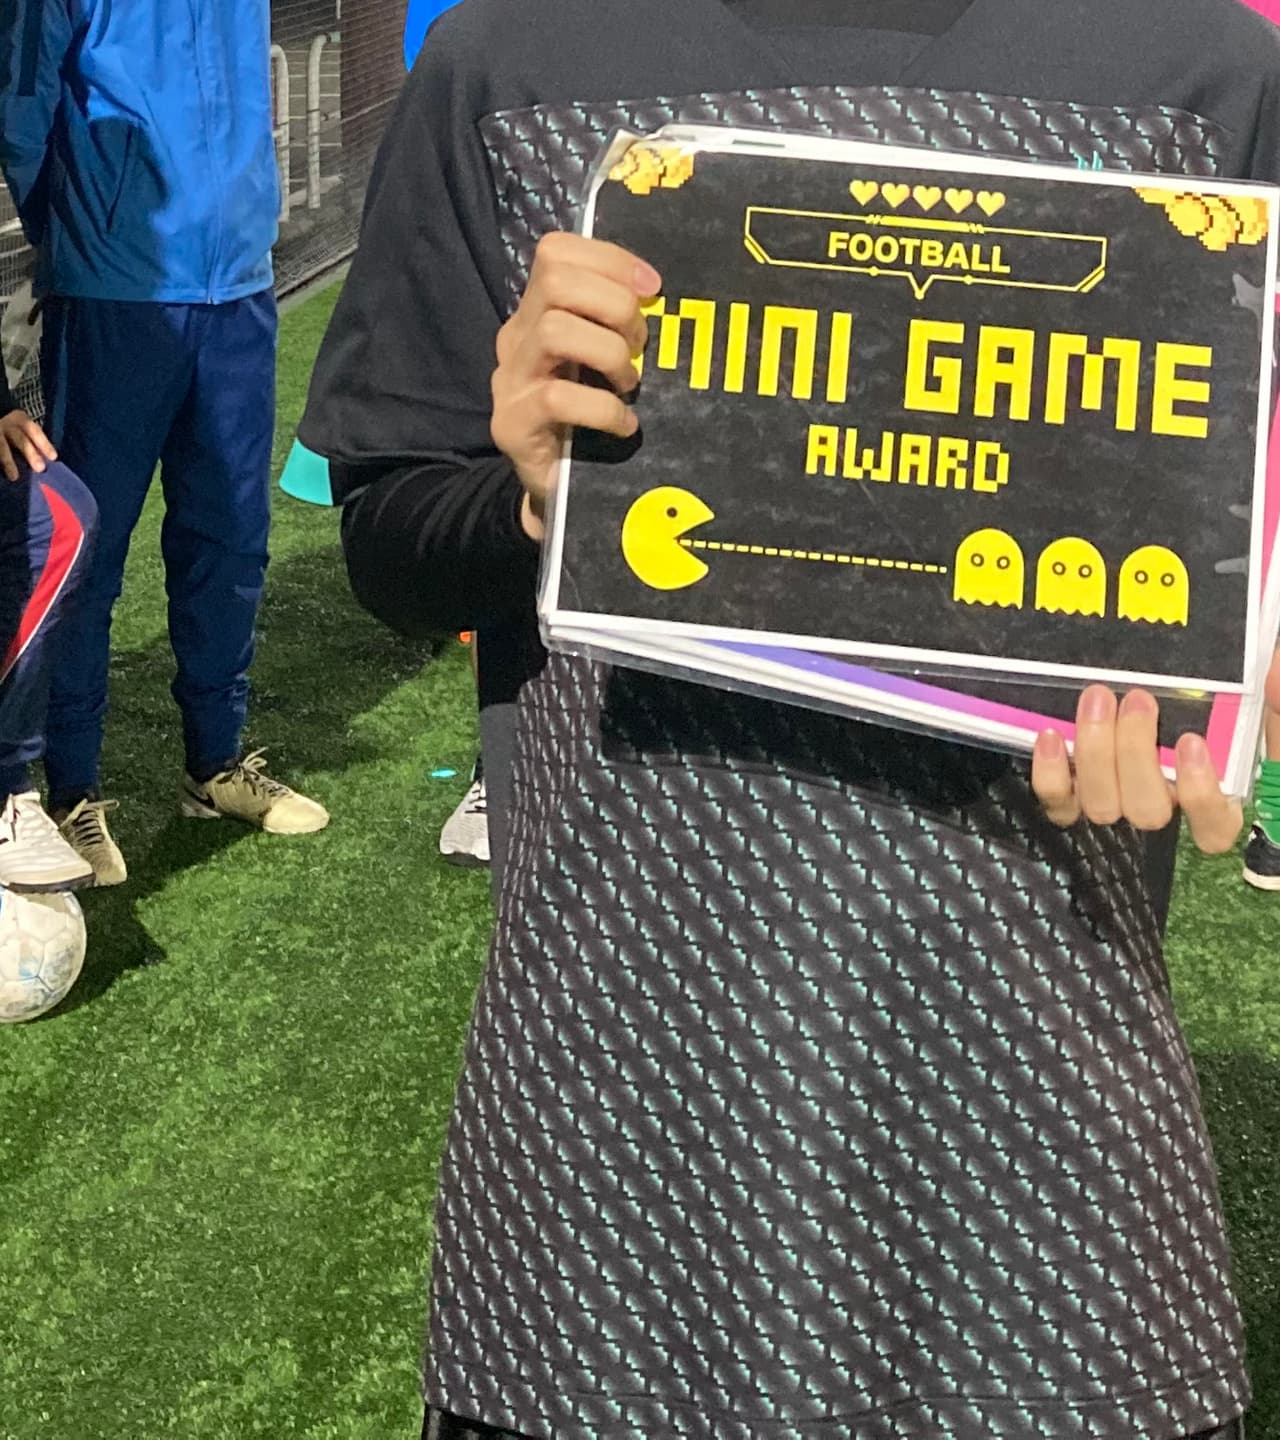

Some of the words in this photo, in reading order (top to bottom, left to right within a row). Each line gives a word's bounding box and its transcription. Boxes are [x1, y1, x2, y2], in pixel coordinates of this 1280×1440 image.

[828, 231, 1011, 273] FOOTBALL
[632, 295, 853, 403] MINI
[904, 318, 1213, 438] GAME
[805, 424, 1010, 494] AWARD
